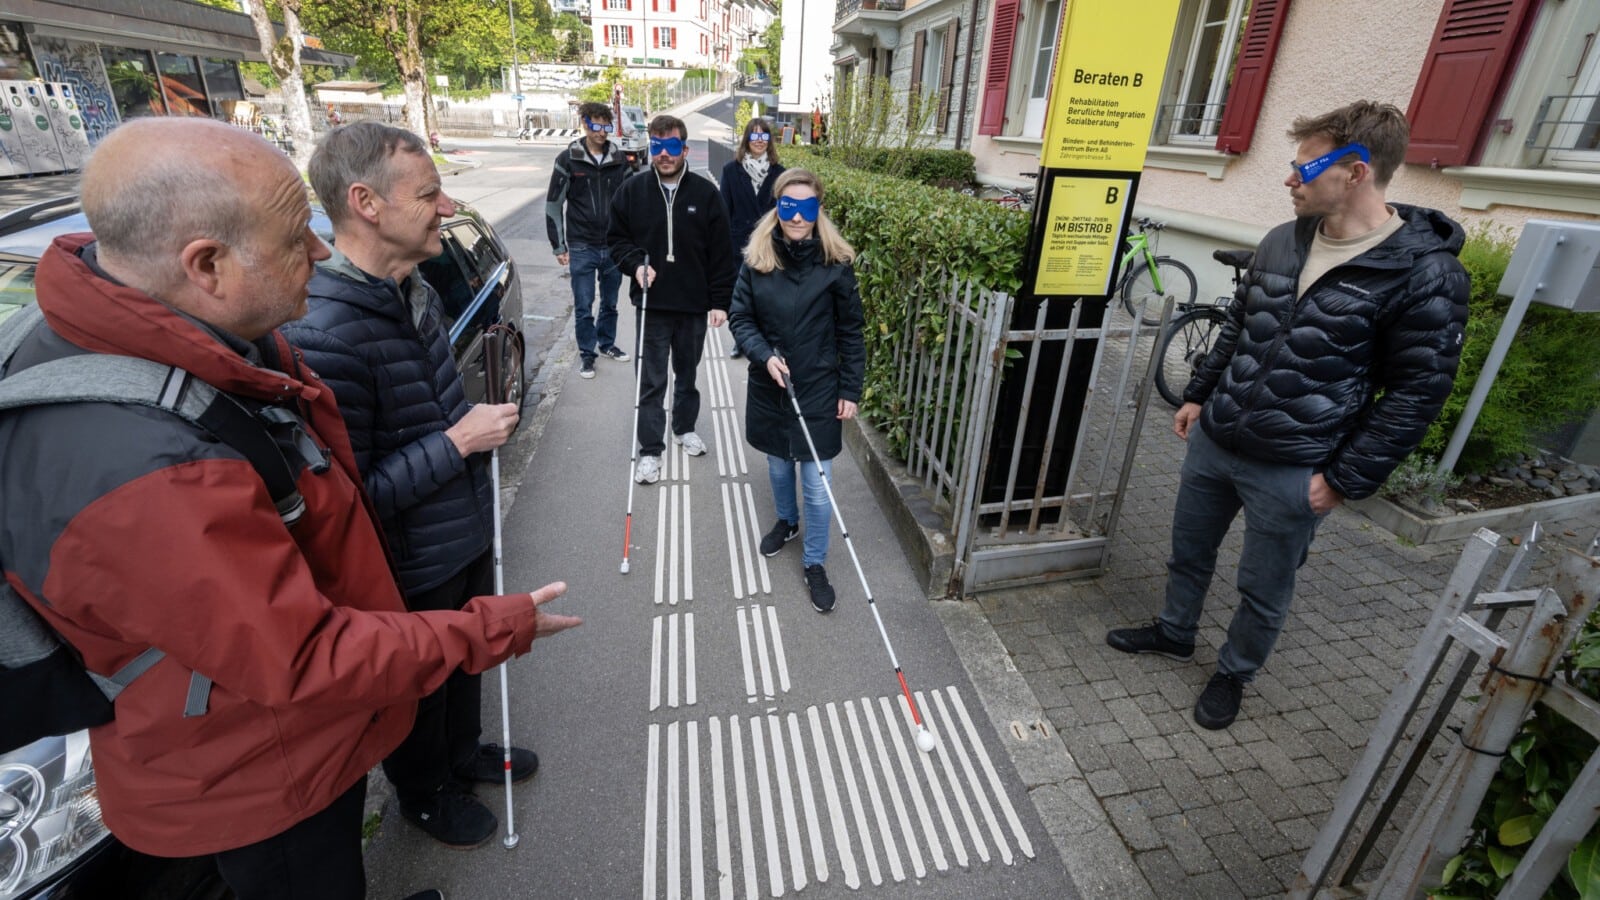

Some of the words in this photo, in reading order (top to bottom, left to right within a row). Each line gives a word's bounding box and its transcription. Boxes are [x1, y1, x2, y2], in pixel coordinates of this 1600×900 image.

[1073, 68, 1129, 87] Beraten
[1132, 72, 1144, 88] B
[1069, 97, 1119, 108] Rehabilitation
[1068, 106, 1105, 117] Berufliche
[1106, 109, 1146, 120] Integration
[1066, 116, 1120, 129] Sozialberatung
[1105, 186, 1119, 205] B
[1053, 222, 1066, 232] IM
[1067, 222, 1104, 233] BISTRO
[1104, 223, 1113, 233] B
